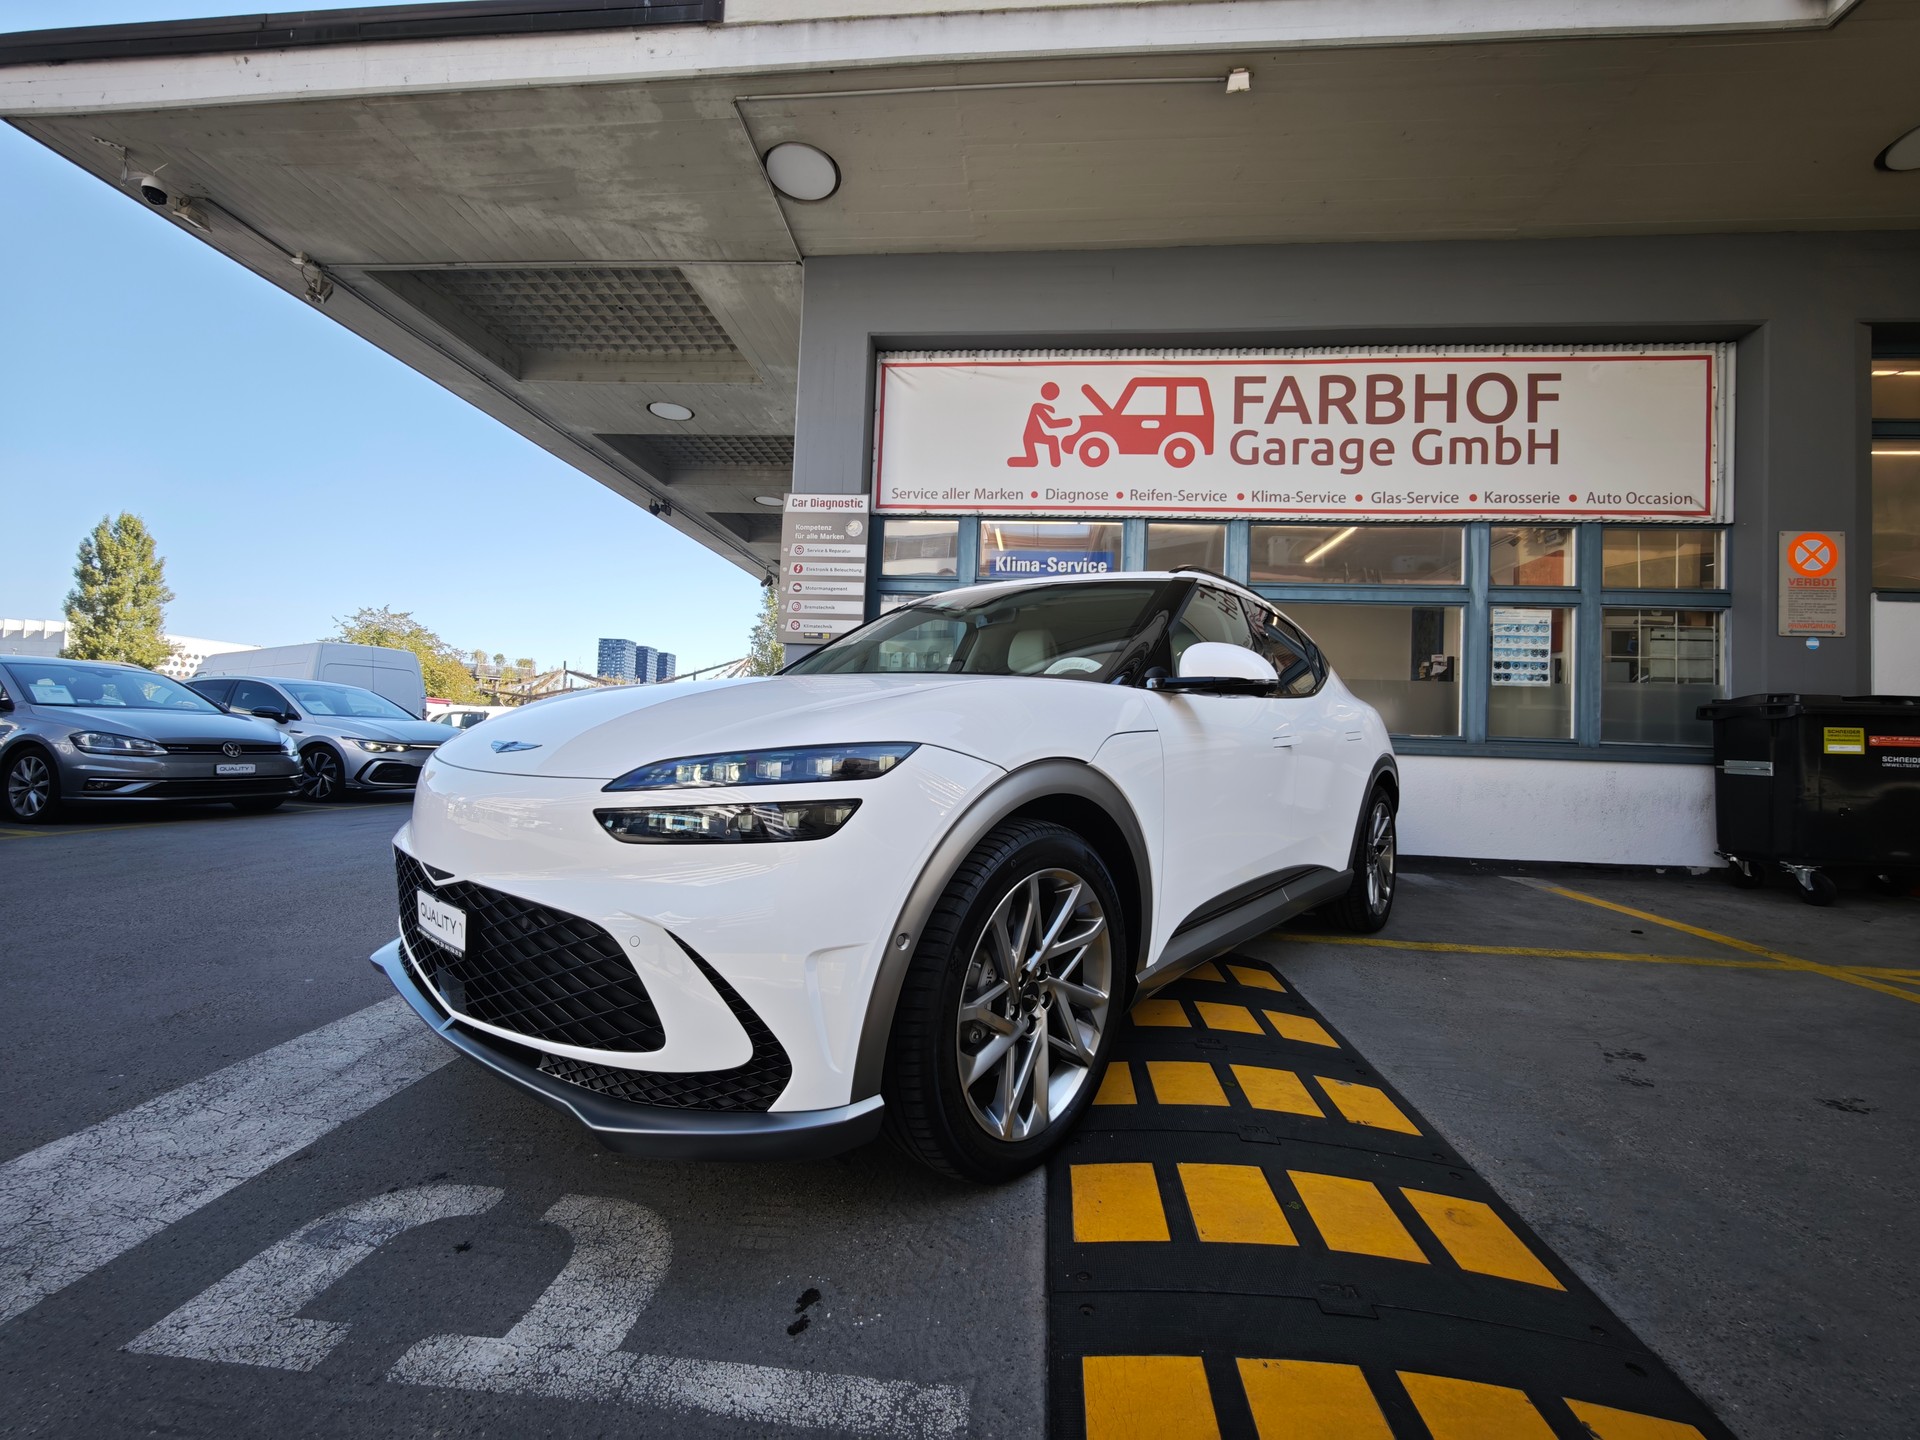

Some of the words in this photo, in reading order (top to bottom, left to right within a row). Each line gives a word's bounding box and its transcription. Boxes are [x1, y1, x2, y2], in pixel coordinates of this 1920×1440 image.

[1233, 373, 1562, 425] FARBHOF
[1229, 428, 1395, 475] Garage
[1411, 425, 1560, 466] GmbH
[891, 487, 938, 501] Service
[941, 487, 971, 501] aller
[973, 487, 1024, 501] Marken
[1045, 487, 1109, 504] Diagnose
[1130, 488, 1228, 502] Reifen-Service
[1250, 490, 1347, 504] Klima-Service
[1371, 490, 1460, 505] Glas-Service
[1484, 491, 1561, 505] Karosserie
[1586, 491, 1622, 505] Auto
[1625, 491, 1694, 506] Occasion
[792, 498, 807, 508] Car
[810, 498, 864, 510] Diagnostic
[795, 523, 832, 533] Kompetenz
[820, 533, 845, 541] Marken
[995, 556, 1108, 573] Klima-Service
[1787, 578, 1837, 587] VERBOT
[805, 585, 848, 593] Motormanagement
[219, 765, 250, 773] QUALITY
[420, 902, 457, 935] QUALITY
